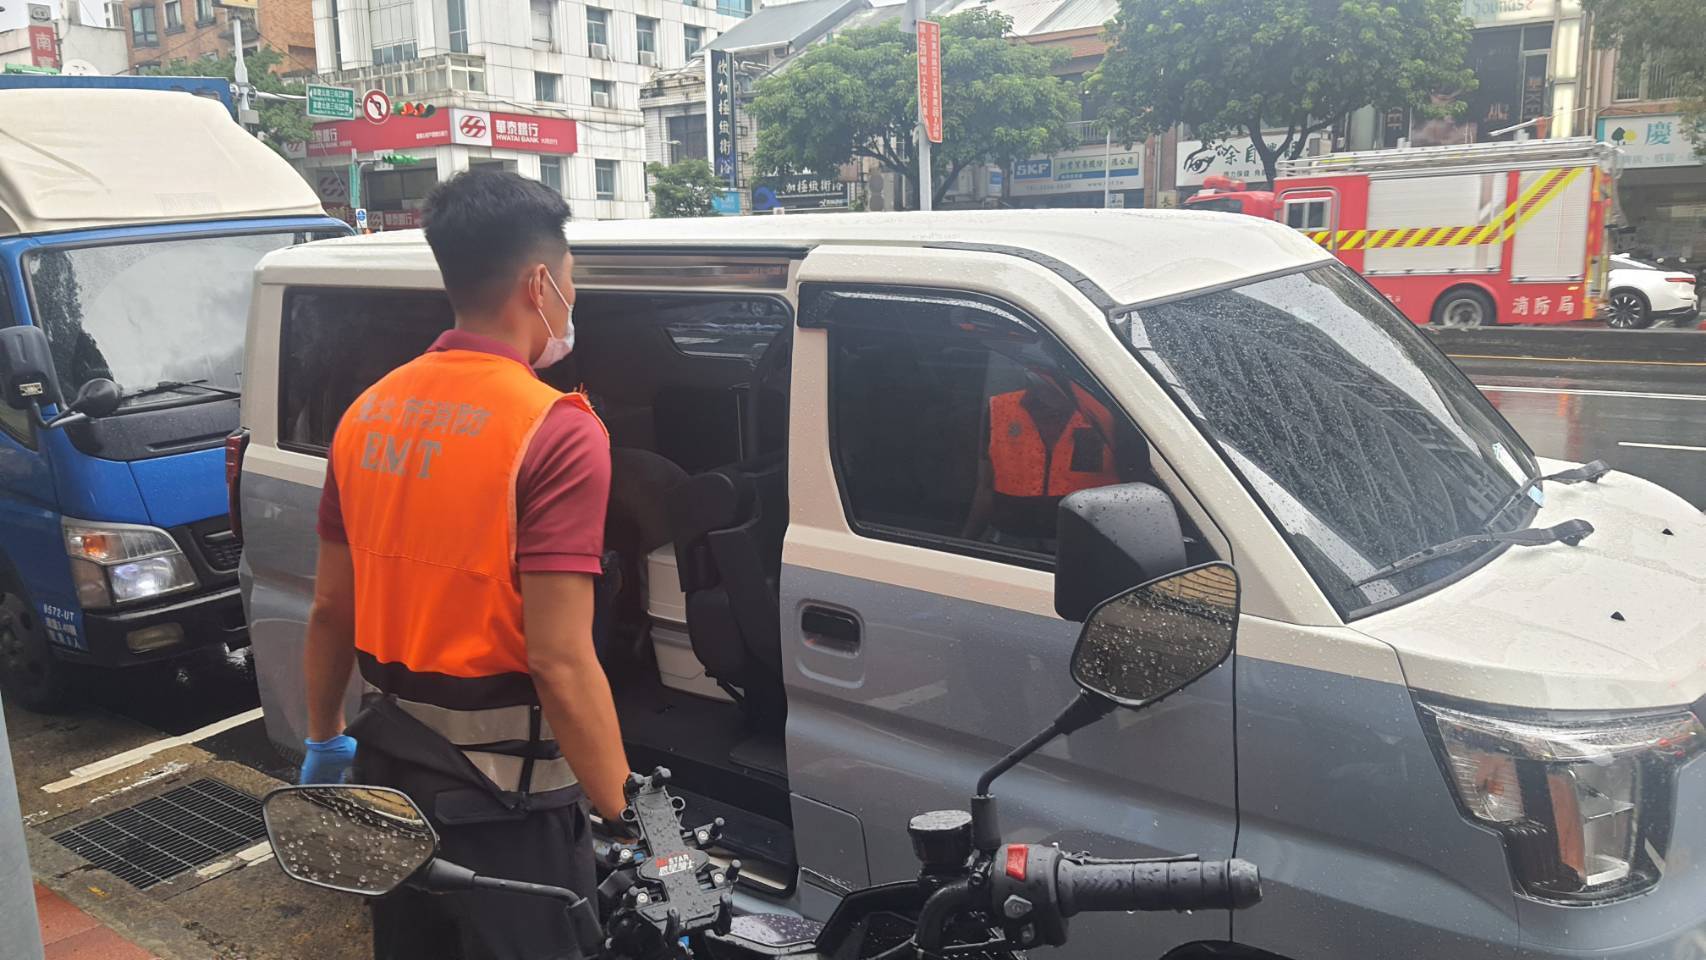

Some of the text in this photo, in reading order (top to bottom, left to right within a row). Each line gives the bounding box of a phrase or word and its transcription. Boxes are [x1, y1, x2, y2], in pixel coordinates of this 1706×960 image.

[496, 120, 539, 137] 華泰銀行
[521, 136, 539, 144] BANK
[1016, 163, 1049, 176] SKF
[1512, 295, 1576, 315] 消防局
[360, 431, 443, 479] EMT
